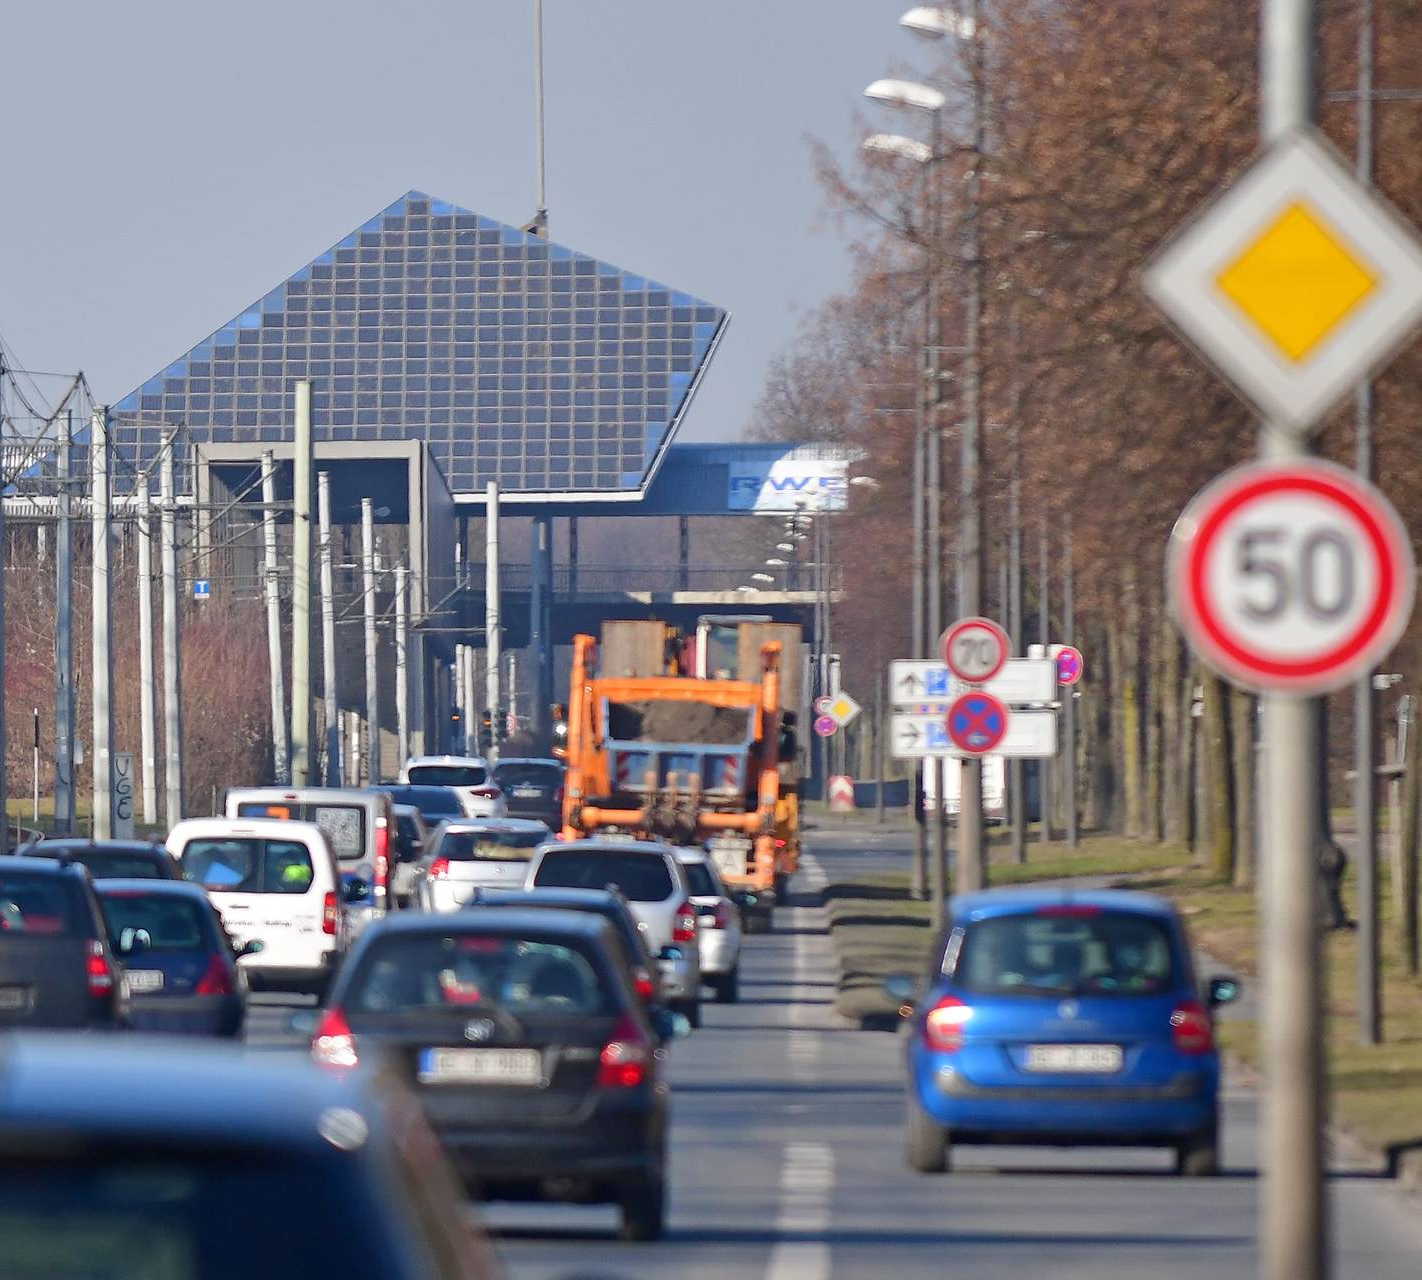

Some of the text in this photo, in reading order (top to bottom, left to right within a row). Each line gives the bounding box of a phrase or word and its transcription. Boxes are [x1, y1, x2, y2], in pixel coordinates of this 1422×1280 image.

[730, 476, 845, 492] RWE
[1236, 527, 1355, 622] 50
[958, 636, 995, 667] 70
